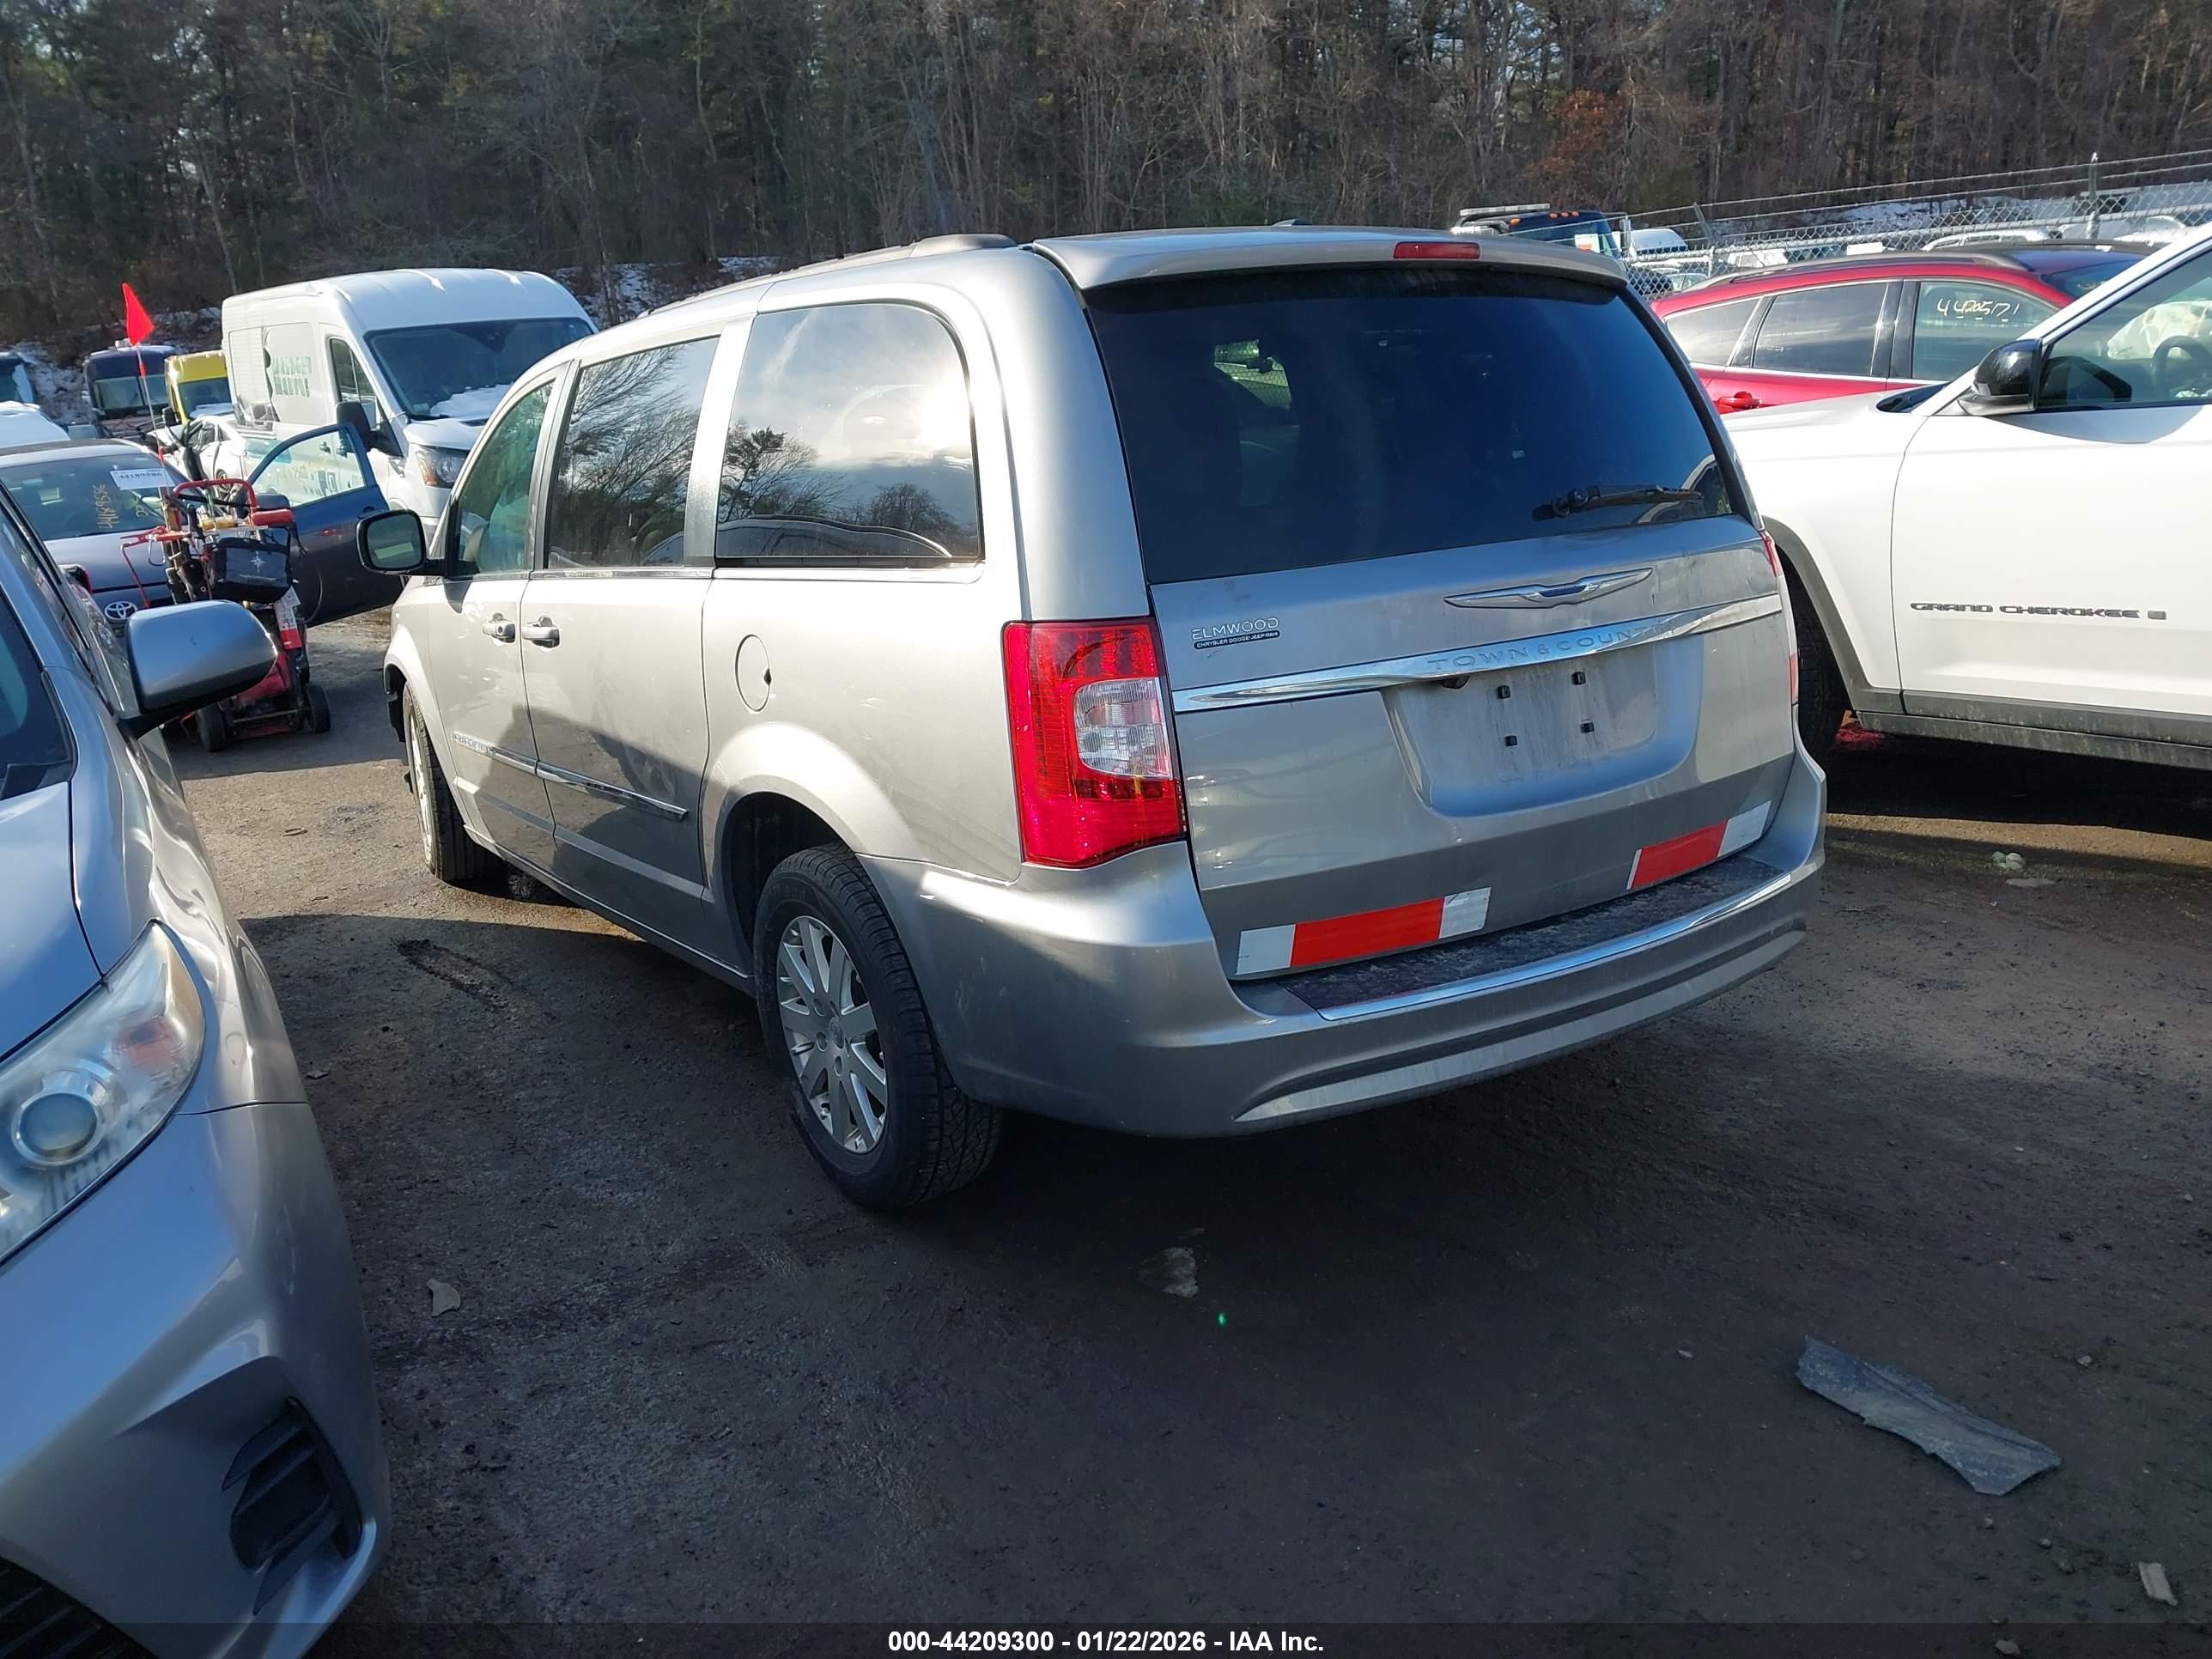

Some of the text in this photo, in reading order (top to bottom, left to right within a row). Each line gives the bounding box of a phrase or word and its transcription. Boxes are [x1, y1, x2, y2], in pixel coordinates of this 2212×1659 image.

[1911, 603, 2141, 619] GRAND CHEROKEE
[1191, 617, 1279, 640] ELMWOOD
[1196, 638, 1228, 648] CHRYSLER
[1427, 646, 1528, 671] TOWN
[1536, 641, 1551, 656] &
